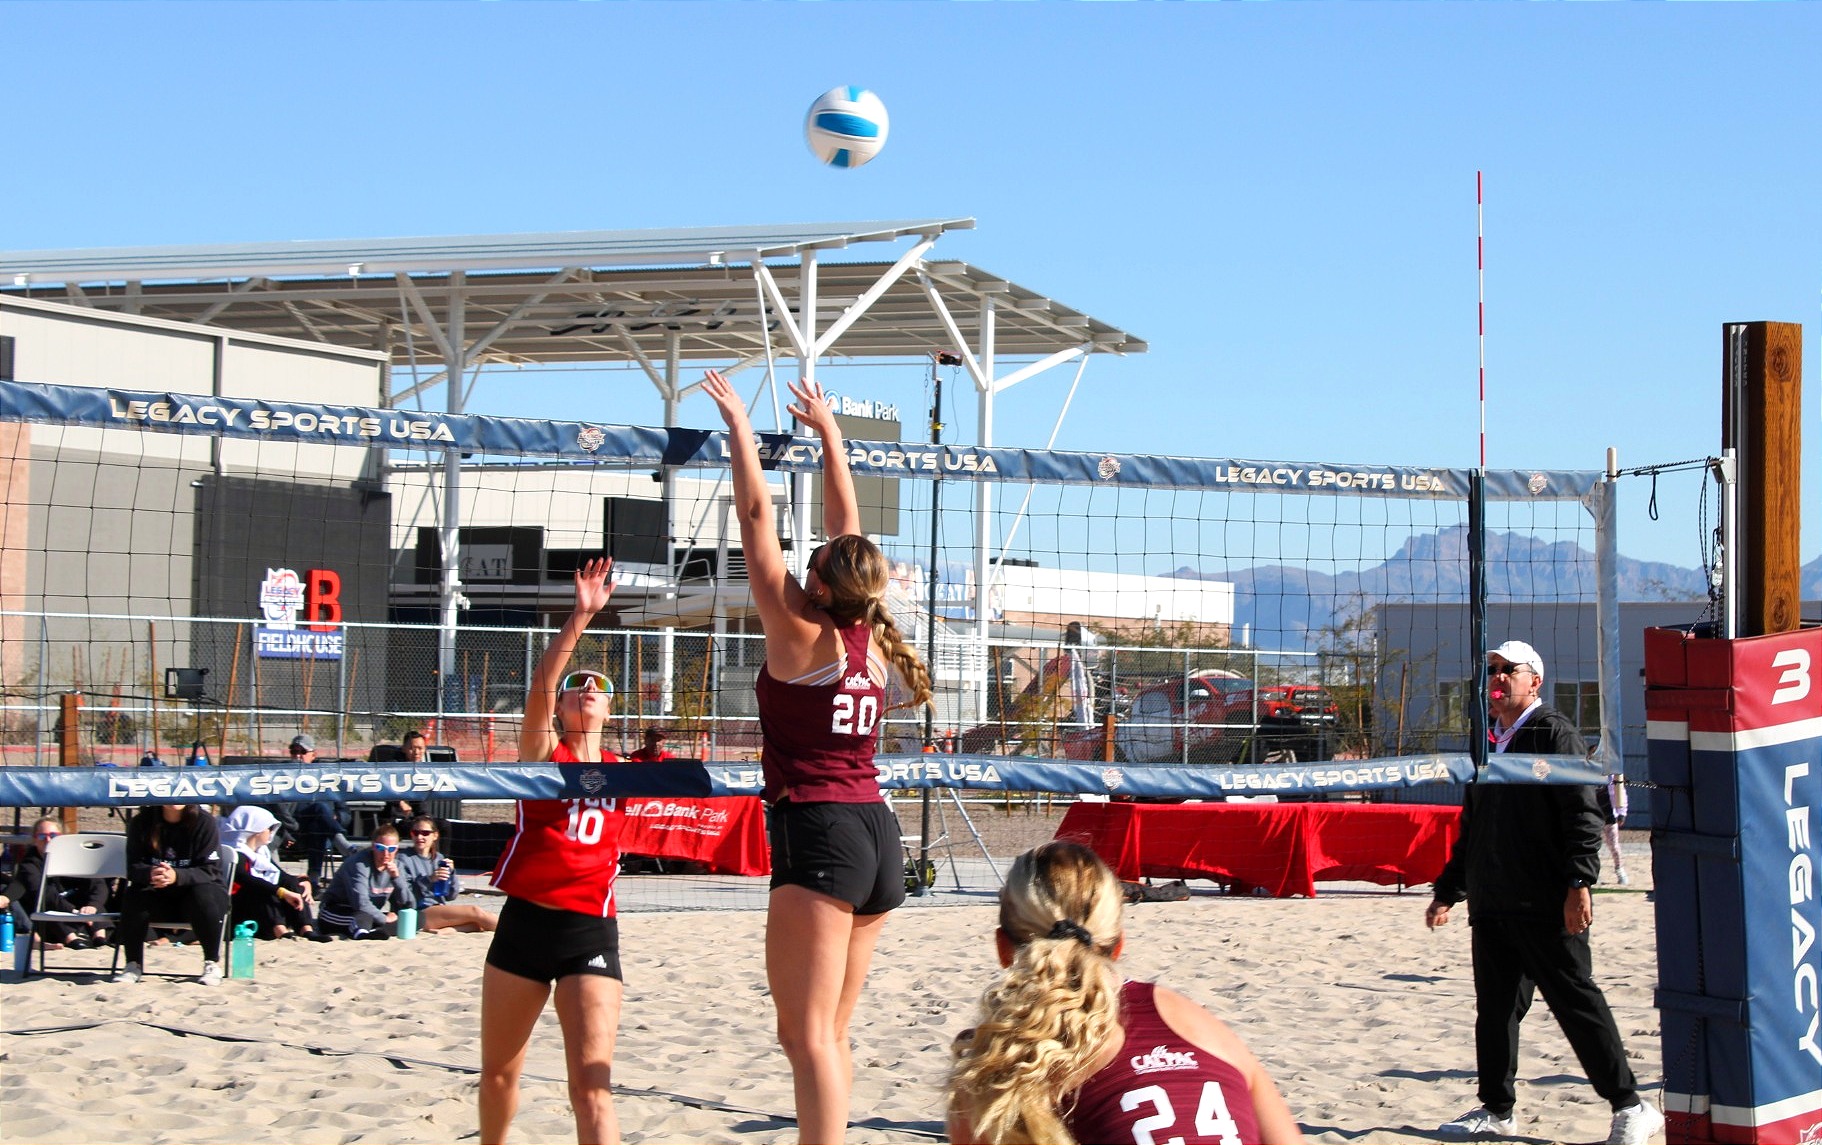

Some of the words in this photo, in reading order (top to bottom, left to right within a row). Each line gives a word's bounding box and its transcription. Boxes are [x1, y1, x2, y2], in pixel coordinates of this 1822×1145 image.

[110, 398, 242, 426] LEGACY
[248, 410, 382, 437] SPORTS
[389, 418, 456, 442] USA
[841, 396, 873, 419] Bank
[874, 401, 899, 422] Park
[720, 439, 823, 463] LGACY
[943, 453, 998, 473] USA
[1214, 465, 1303, 485] LEGACY
[1307, 470, 1396, 490] SPORTS
[1401, 474, 1446, 492] USA
[307, 569, 342, 632] B
[258, 632, 342, 655] FIELDHOUSE
[1771, 648, 1812, 706] 3
[831, 693, 878, 736] 20
[108, 777, 241, 798] LEGACY
[250, 773, 383, 796] SPORTS
[389, 773, 458, 793] USA
[874, 762, 943, 783] ORTS
[949, 763, 1002, 783] USA
[1219, 771, 1306, 790] LEGACY
[1311, 766, 1402, 788] SPORTS
[1405, 762, 1450, 781] USA
[564, 807, 604, 845] 10
[663, 802, 700, 819] Bank
[699, 807, 730, 823] Park
[1783, 762, 1822, 1068] LEGACY
[1120, 1081, 1243, 1145] 24
